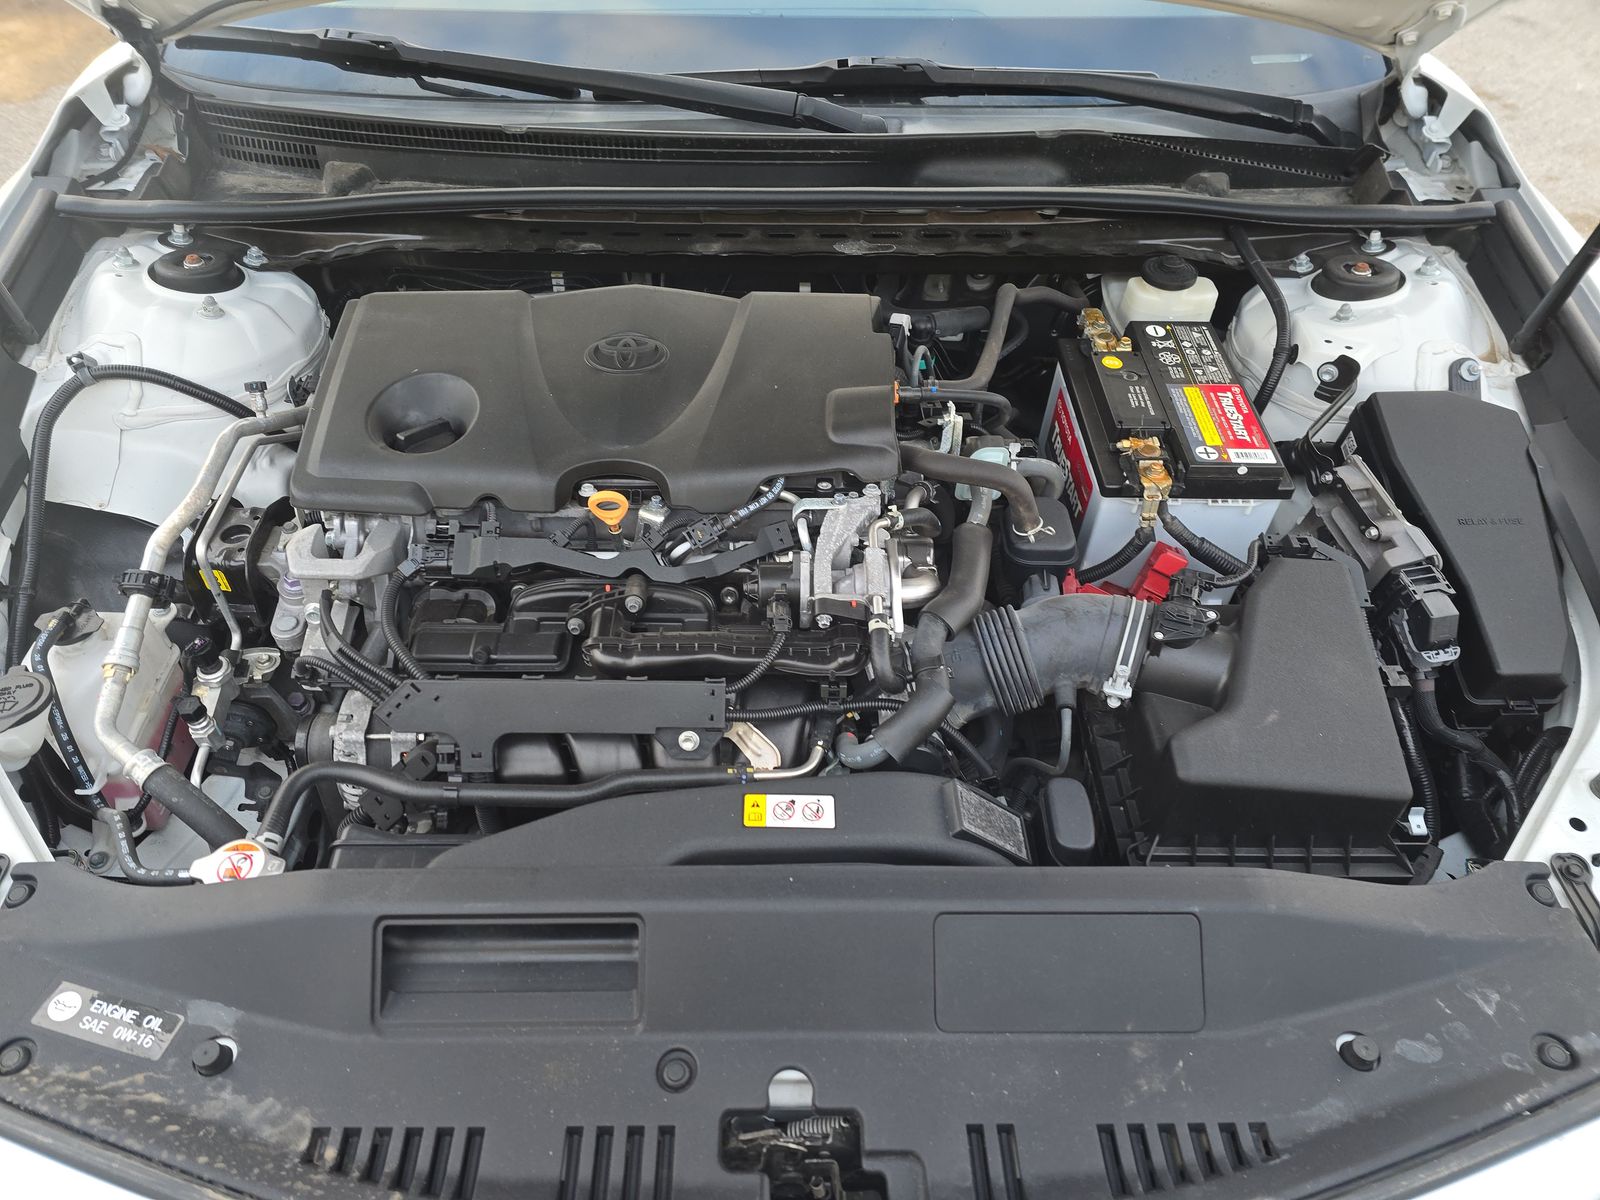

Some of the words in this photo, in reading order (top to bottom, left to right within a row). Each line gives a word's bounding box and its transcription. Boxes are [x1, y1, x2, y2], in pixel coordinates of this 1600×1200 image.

[1235, 394, 1249, 414] TOYOTA
[1498, 518, 1525, 526] FUSE
[79, 1015, 110, 1035] SAE
[90, 999, 140, 1024] ENGINE
[142, 1015, 163, 1032] OIL
